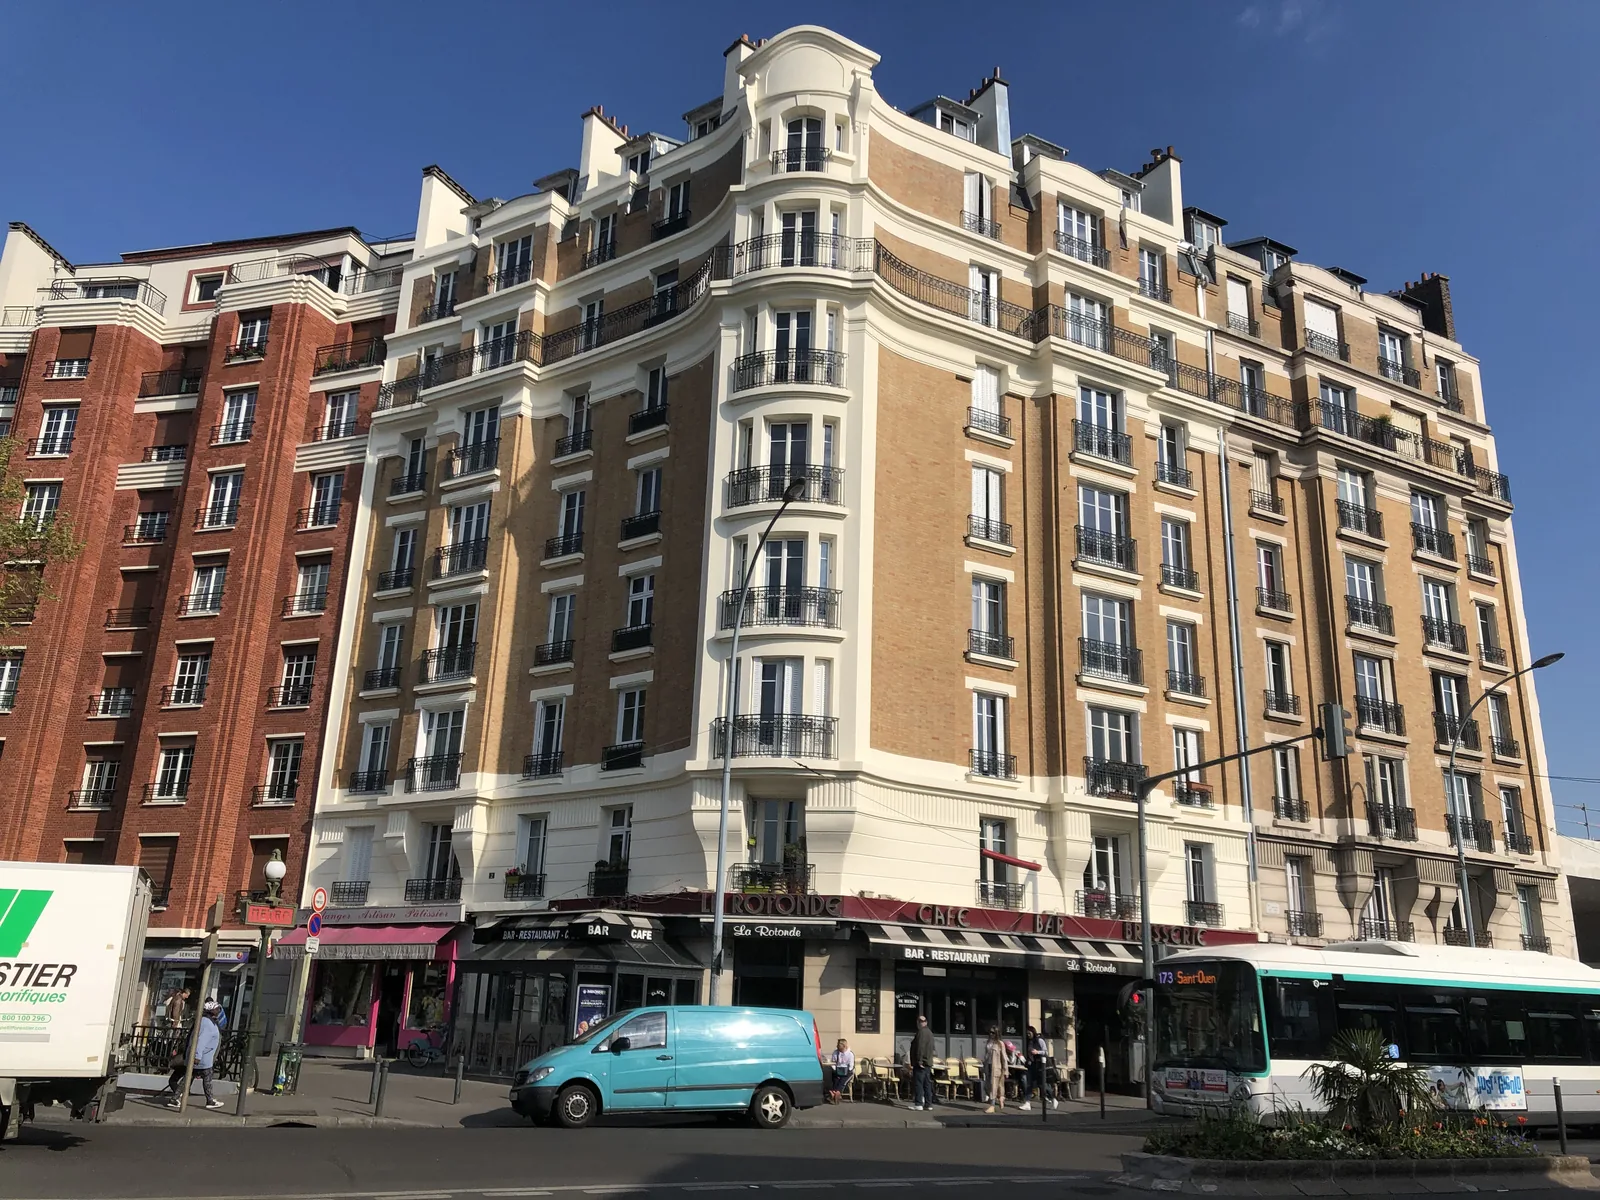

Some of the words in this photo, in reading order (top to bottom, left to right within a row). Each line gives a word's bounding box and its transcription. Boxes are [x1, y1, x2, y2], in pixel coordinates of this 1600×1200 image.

[732, 893, 842, 917] ROTONDE
[358, 909, 396, 919] Artisan
[917, 904, 971, 928] CAFE
[1035, 912, 1064, 935] BAR
[503, 931, 515, 940] BAR
[518, 930, 561, 940] RESTAURANT
[587, 925, 609, 936] BAR
[631, 929, 652, 940] CAFE
[733, 925, 751, 937] La
[754, 926, 801, 937] Rotonde
[1124, 920, 1207, 946] BRSSERIE
[904, 948, 924, 961] BAR
[931, 949, 990, 964] RESTAURANT
[1085, 961, 1117, 974] Rotonde
[1158, 971, 1174, 984] 173
